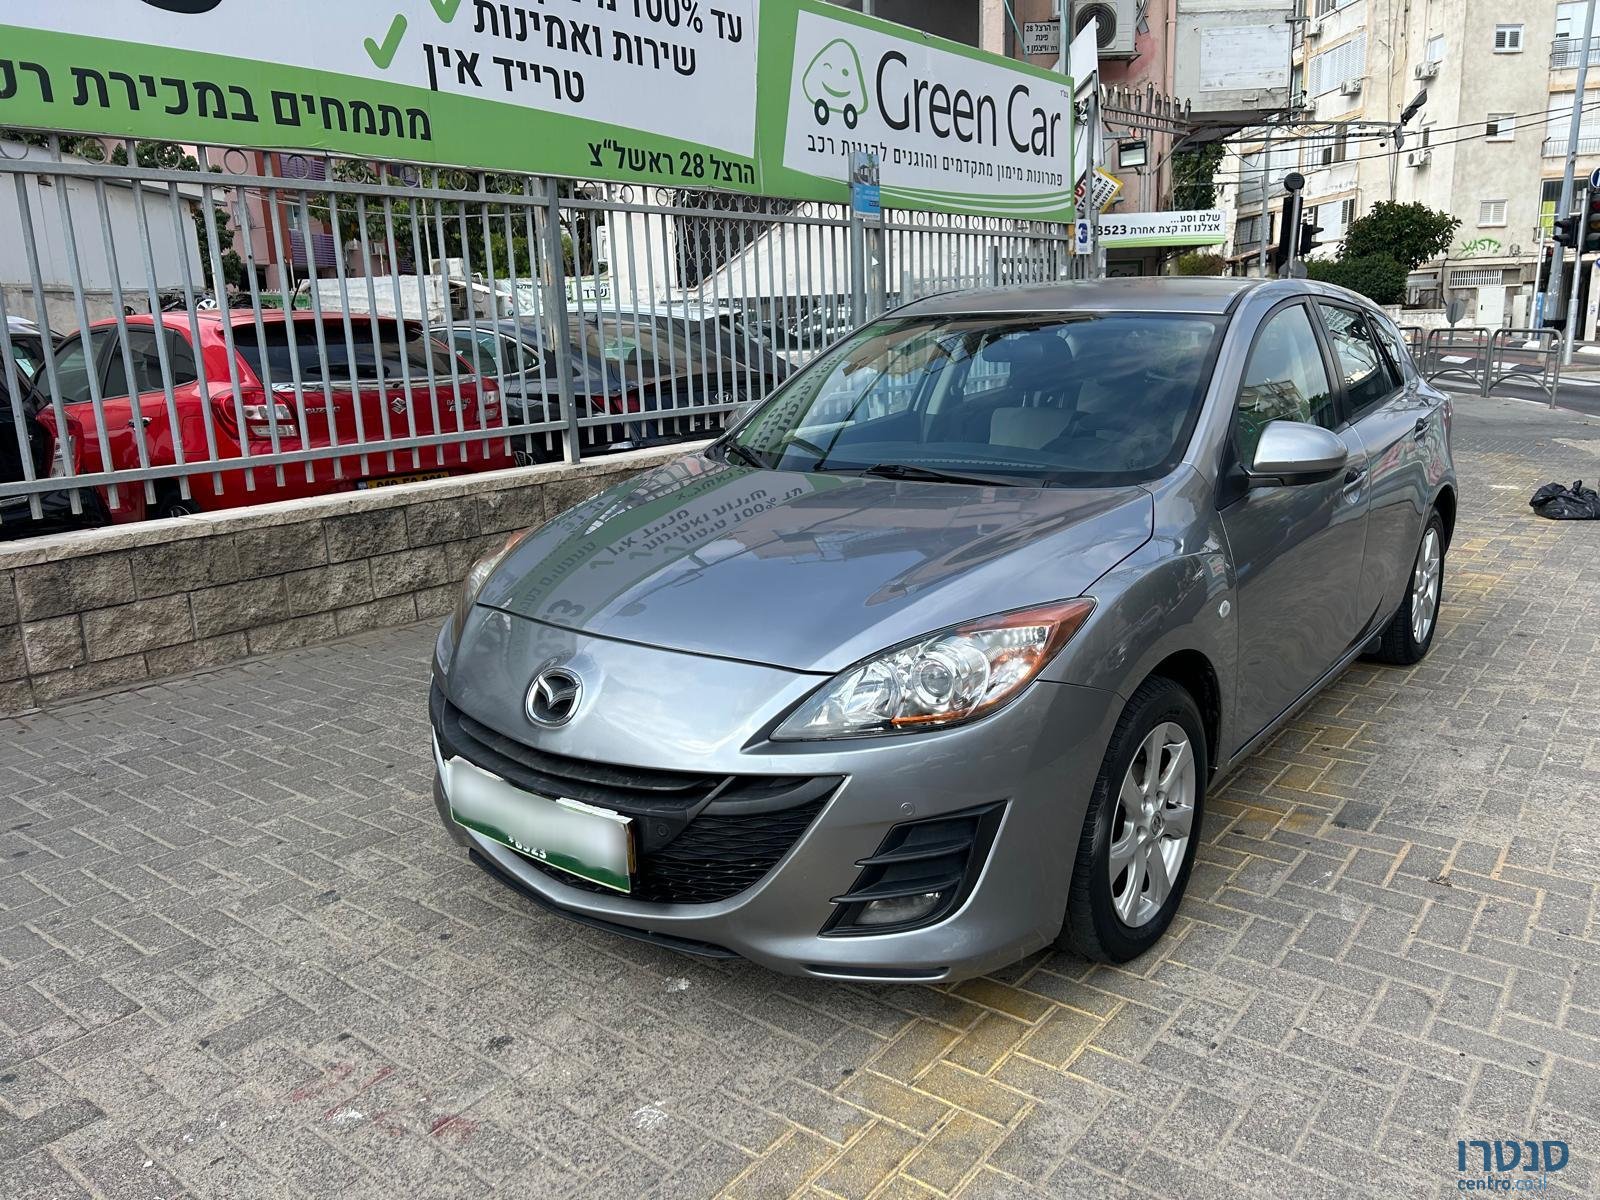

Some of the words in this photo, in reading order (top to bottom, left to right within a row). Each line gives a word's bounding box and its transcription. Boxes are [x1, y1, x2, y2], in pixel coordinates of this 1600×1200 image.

[473, 0, 604, 58] ואמינות
[710, 8, 743, 44] עד
[422, 43, 483, 92] אין
[612, 30, 697, 77] שירות
[492, 56, 585, 103] טרייד
[70, 65, 259, 123] במכירת
[876, 50, 997, 147] Green
[1007, 84, 1061, 158] Car
[270, 89, 432, 142] מתמחים
[807, 134, 835, 155] רכב
[680, 151, 705, 179] 28
[709, 153, 755, 185] הרצל
[893, 148, 938, 171] והוגנים
[942, 156, 994, 179] מתקדמים
[996, 164, 1024, 183] מימון
[1026, 167, 1063, 187] פתרונות
[1129, 226, 1156, 235] אחרת
[1158, 225, 1178, 235] קצת
[1193, 223, 1221, 232] אצלנו
[1199, 213, 1221, 222] שלם
